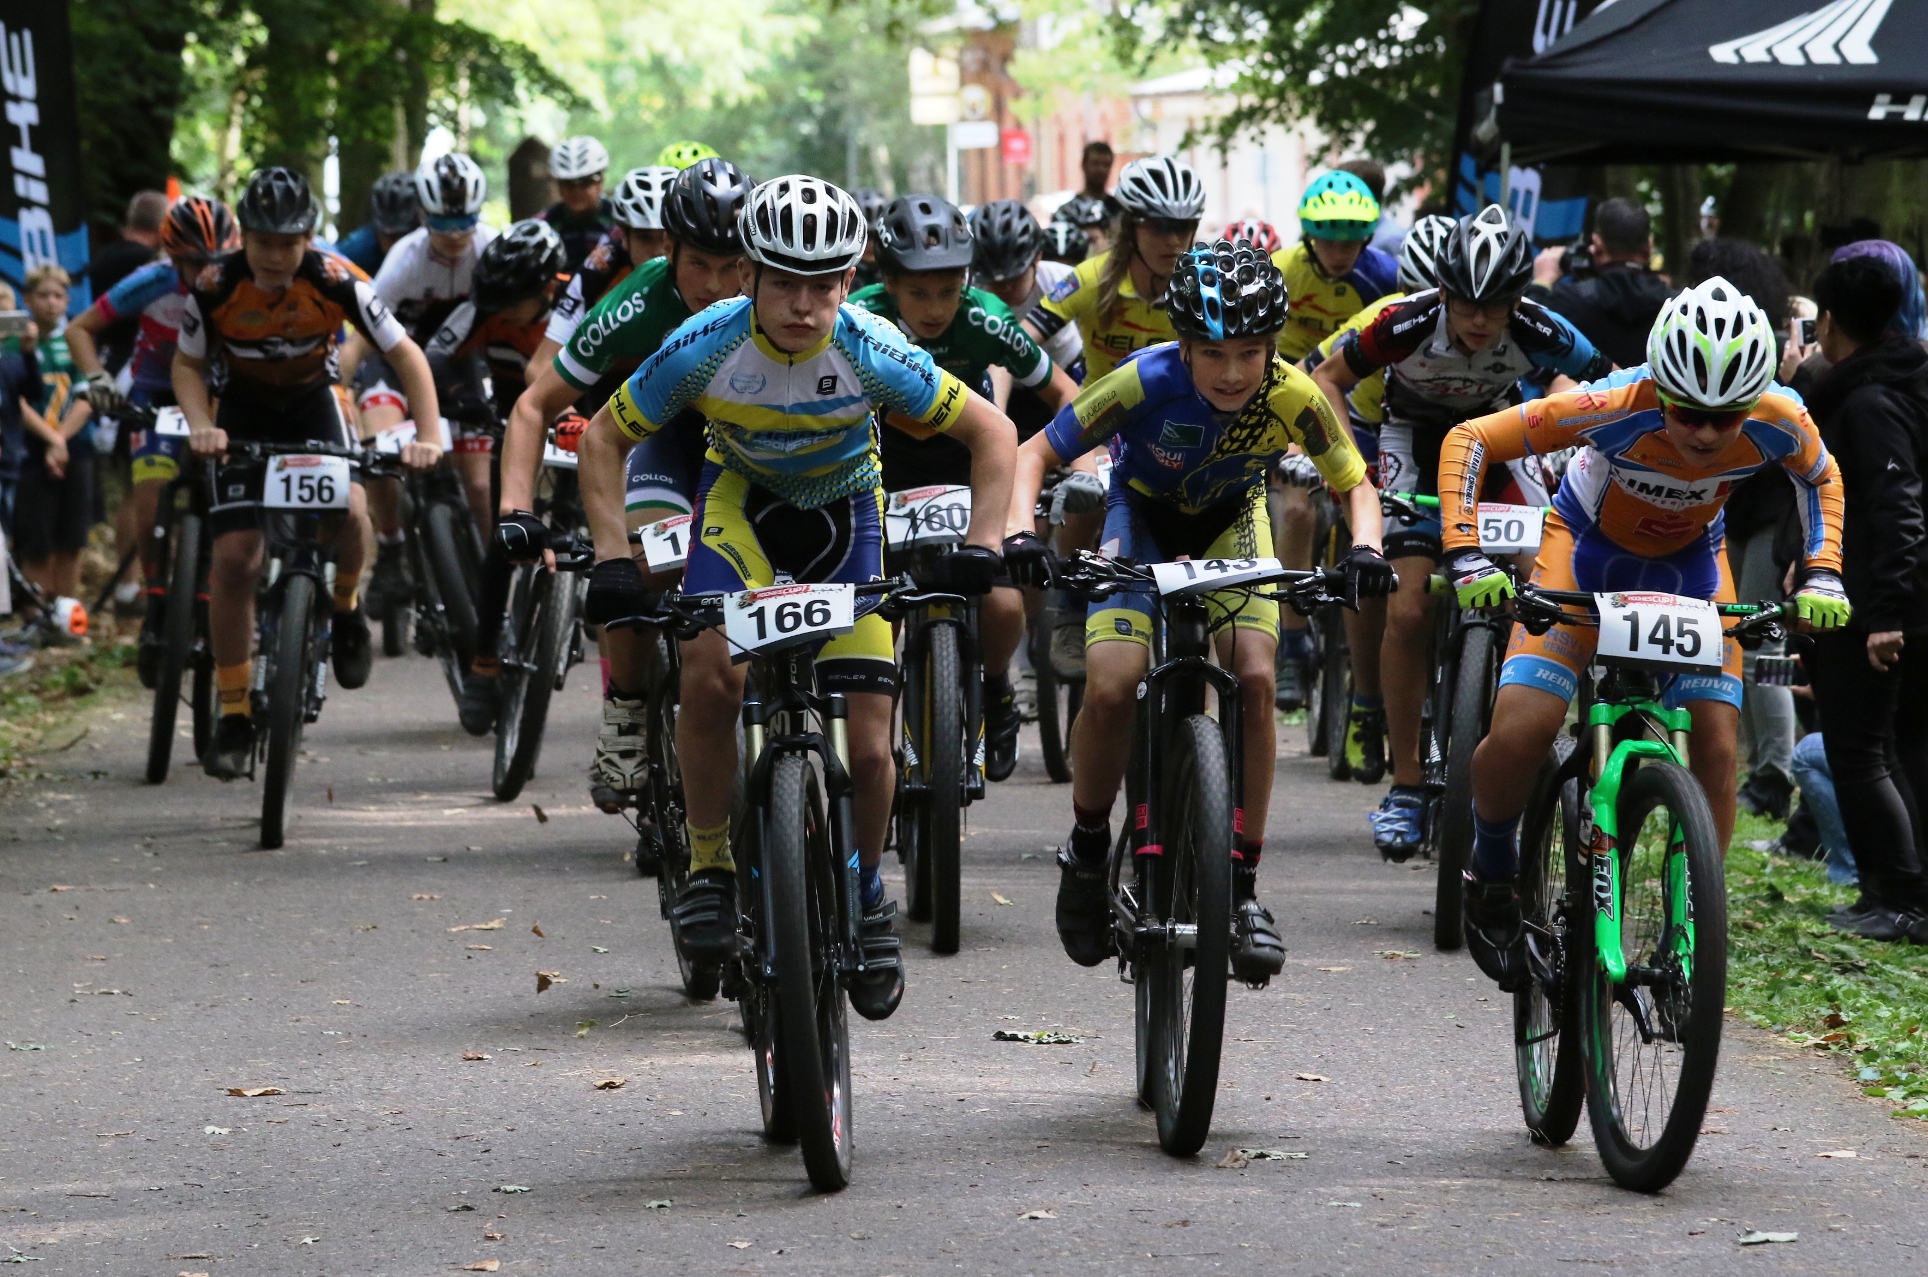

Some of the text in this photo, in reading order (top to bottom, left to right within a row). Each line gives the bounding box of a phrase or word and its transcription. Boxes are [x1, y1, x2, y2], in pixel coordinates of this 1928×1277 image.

[577, 291, 646, 357] COLLOS
[280, 474, 335, 504] 156
[903, 502, 968, 535] 160
[747, 599, 832, 641] 166
[1622, 610, 1702, 658] 145
